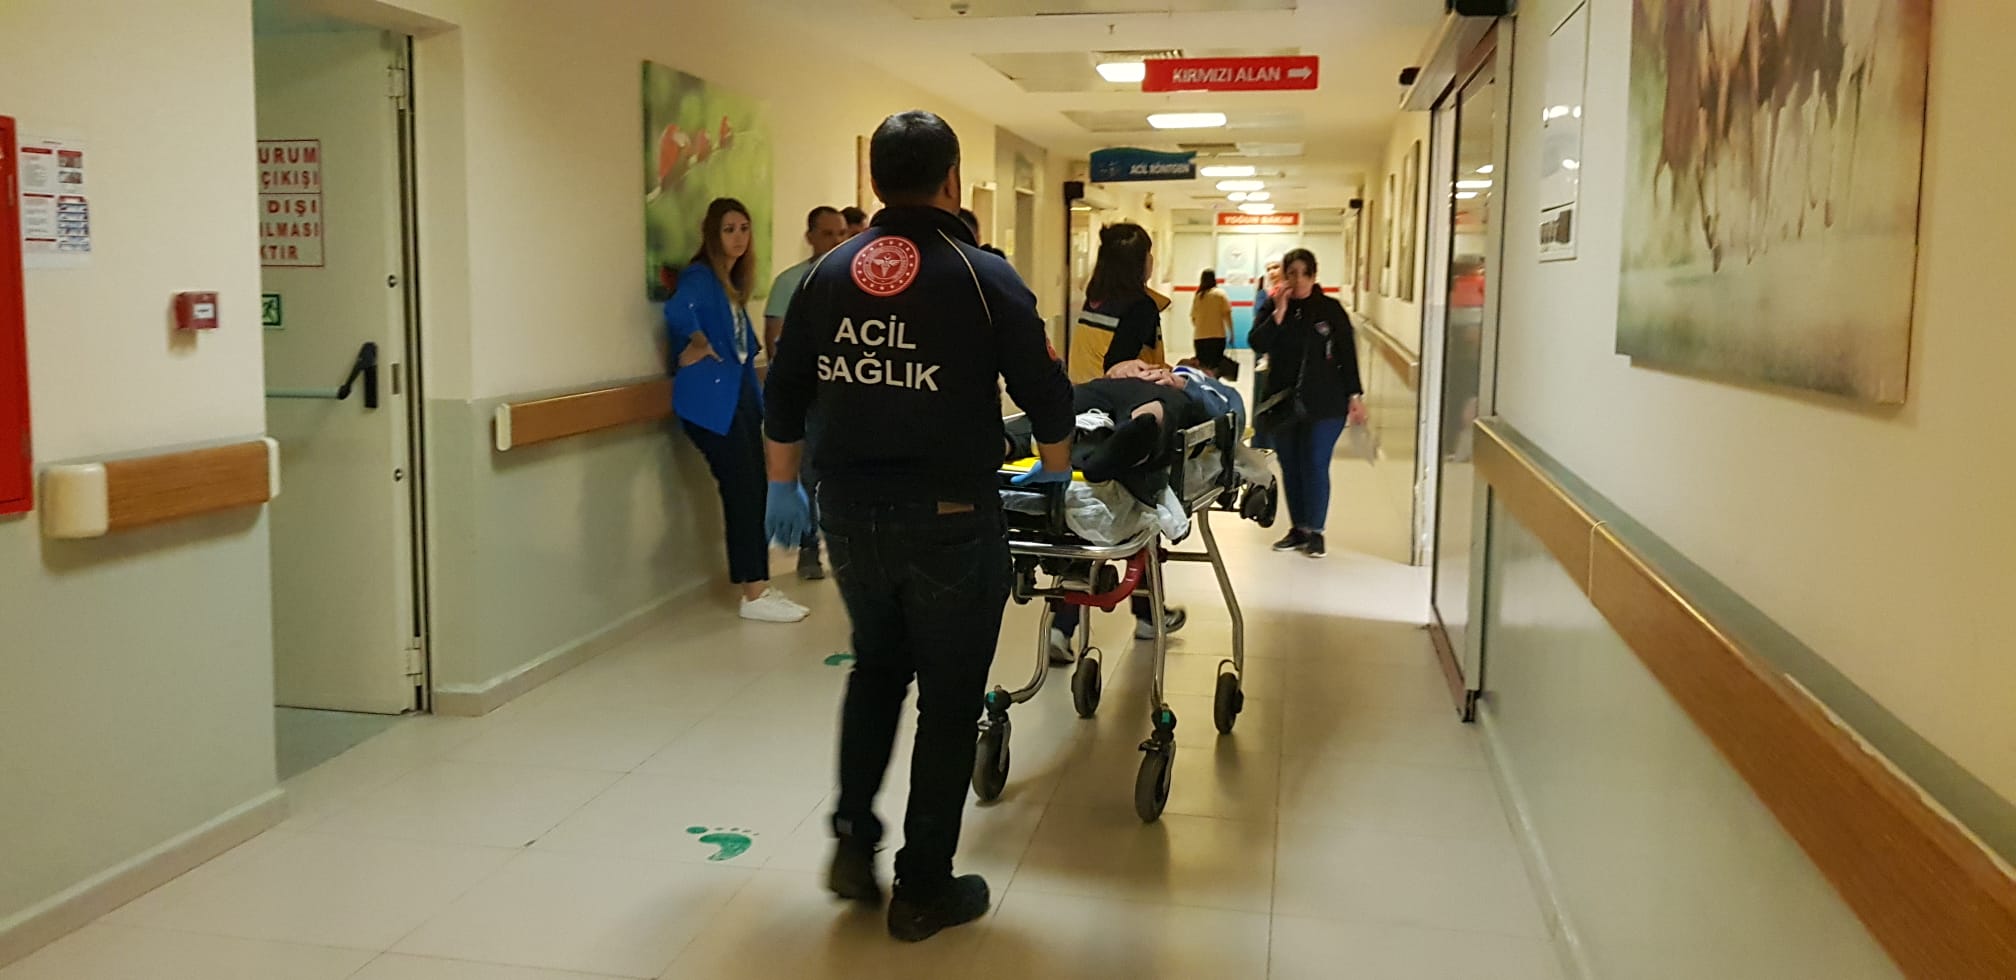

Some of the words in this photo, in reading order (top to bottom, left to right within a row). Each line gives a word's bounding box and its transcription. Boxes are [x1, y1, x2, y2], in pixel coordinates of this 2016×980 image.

[1172, 67, 1233, 83] KIRMIZI
[1235, 66, 1282, 82] ALAN
[267, 199, 317, 217] DIŞI
[834, 314, 917, 350] ACİL
[817, 351, 941, 392] SAĞLIK
